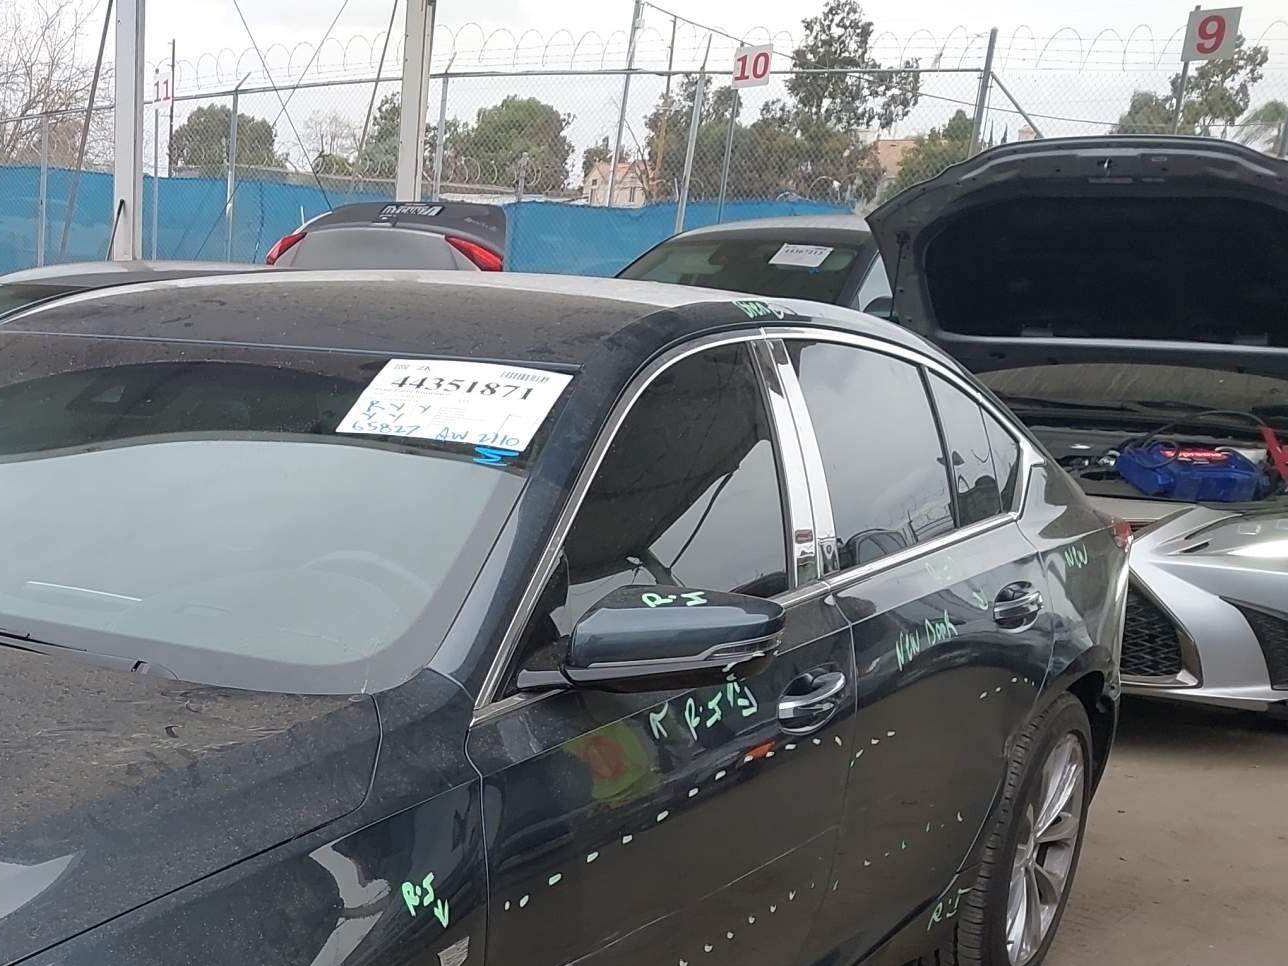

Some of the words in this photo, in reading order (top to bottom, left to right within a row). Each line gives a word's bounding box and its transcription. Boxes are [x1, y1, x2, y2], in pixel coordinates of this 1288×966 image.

[1196, 15, 1226, 54] 9
[734, 52, 770, 80] 10
[154, 79, 171, 103] 11
[391, 375, 534, 400] 44351871
